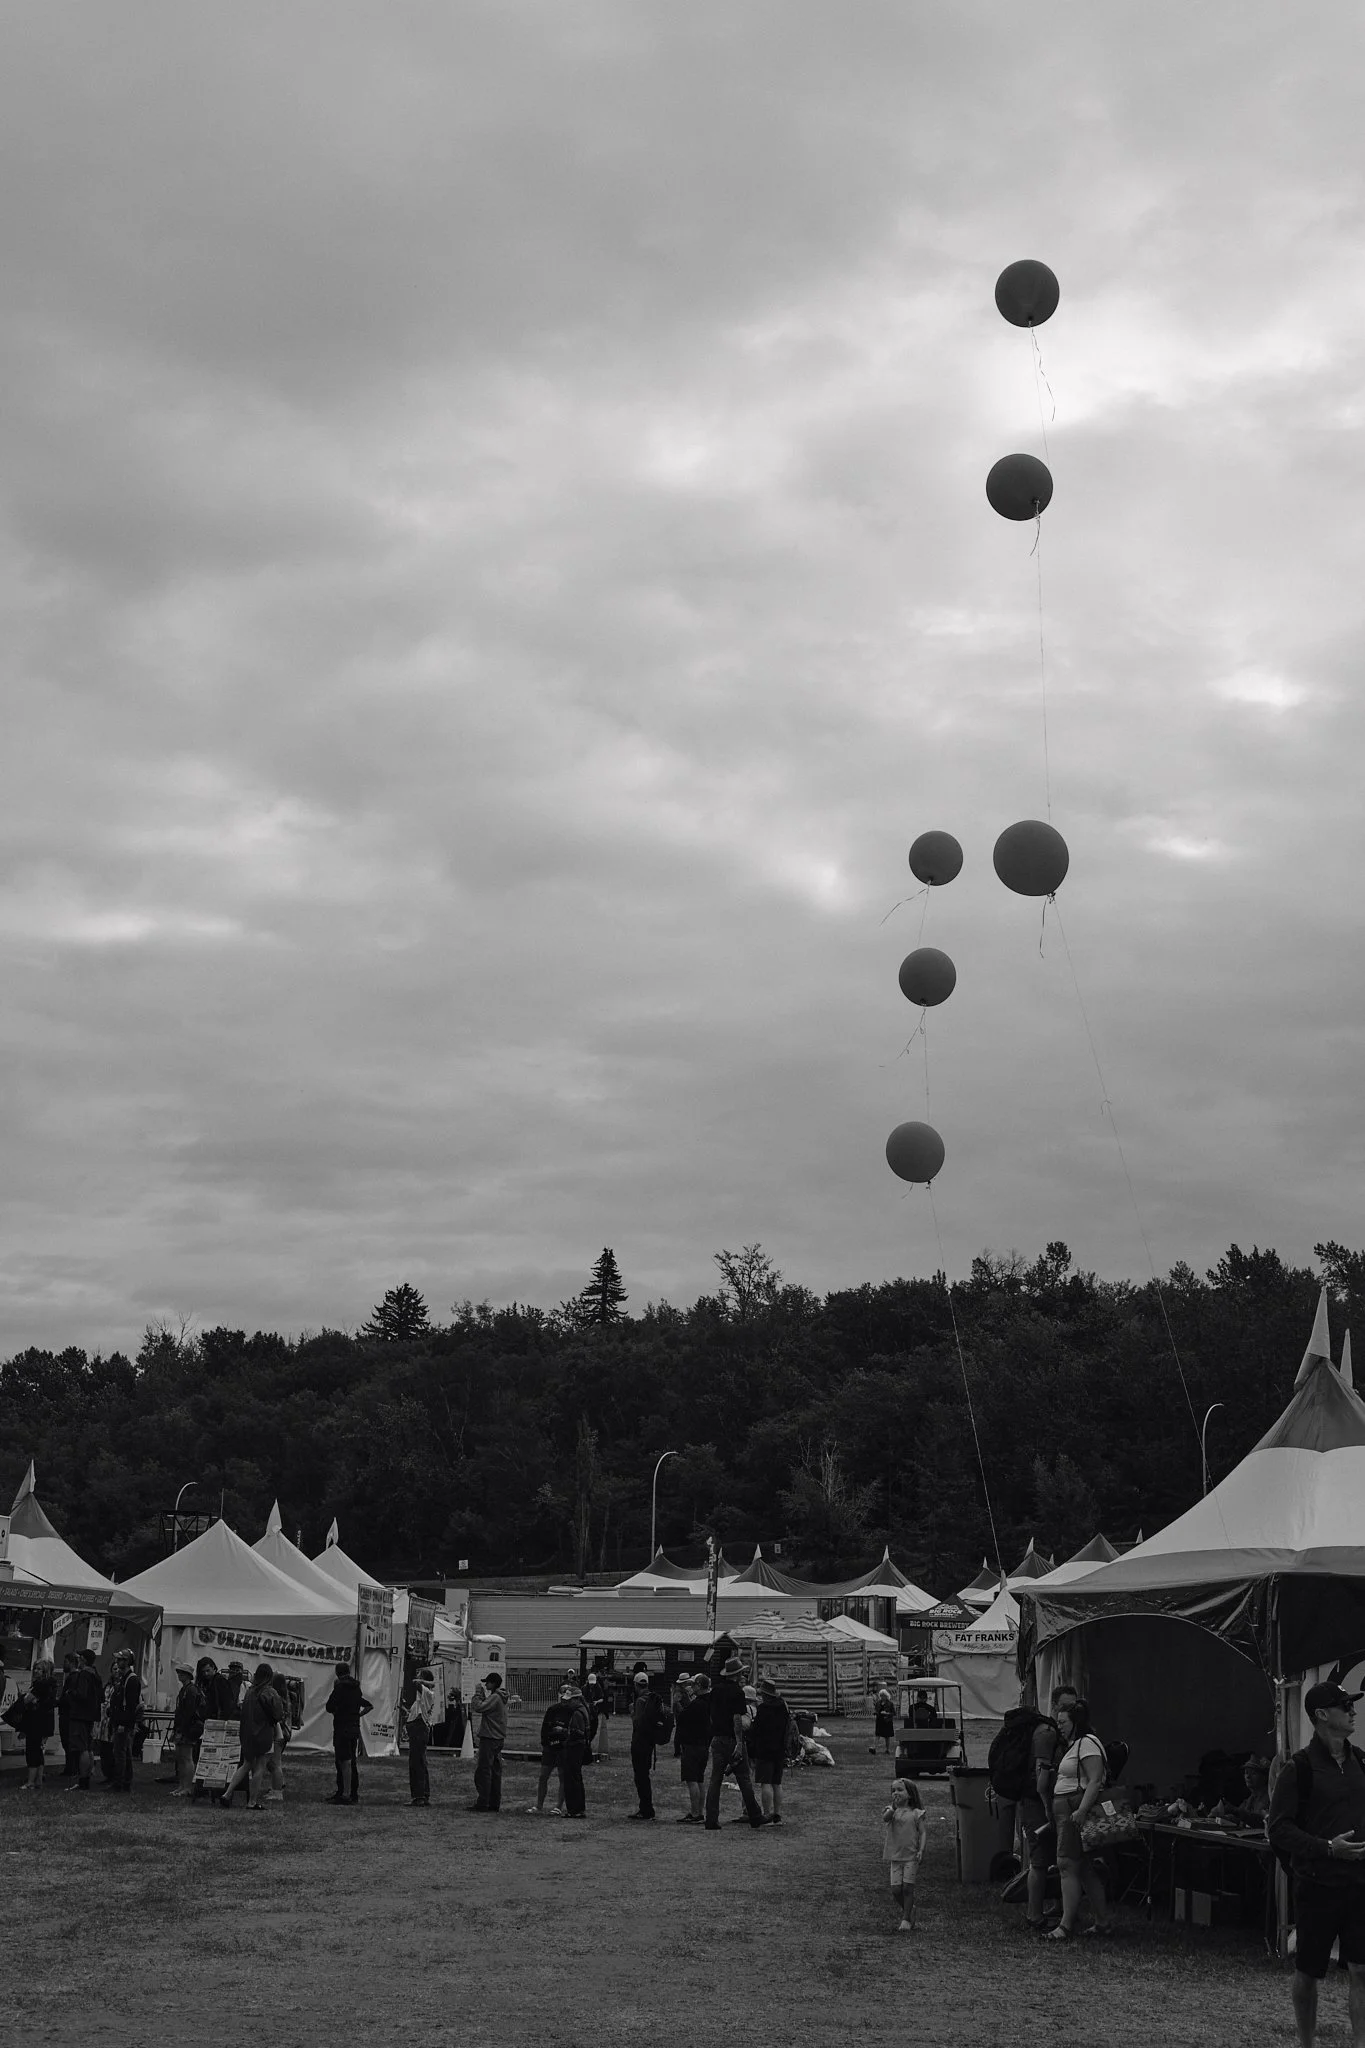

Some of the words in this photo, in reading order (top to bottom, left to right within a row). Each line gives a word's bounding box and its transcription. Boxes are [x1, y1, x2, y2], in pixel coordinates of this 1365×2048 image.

[93, 1620, 103, 1628] PLATE
[940, 1621, 970, 1629] BREWERY
[955, 1634, 973, 1642] FAT
[975, 1633, 1015, 1642] FRANKS
[217, 1630, 262, 1651] GREEN
[262, 1639, 306, 1657] ONION
[308, 1646, 352, 1662] CAKES
